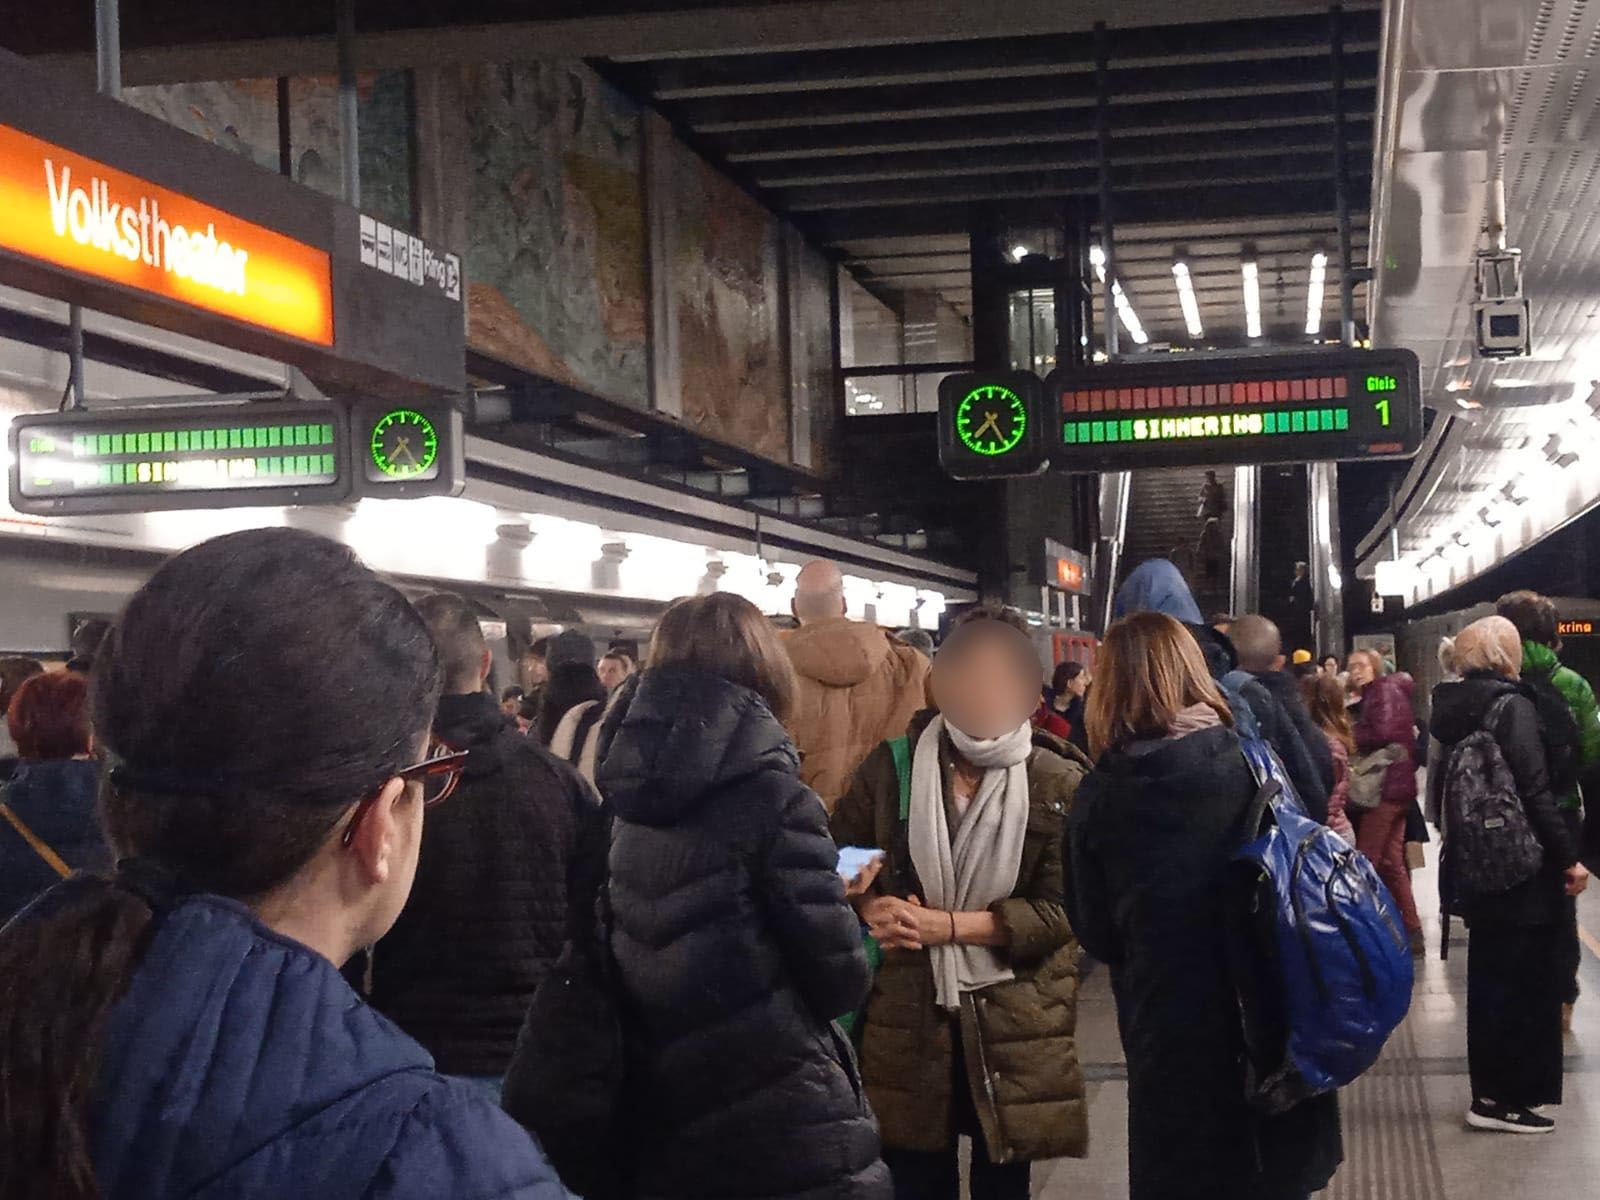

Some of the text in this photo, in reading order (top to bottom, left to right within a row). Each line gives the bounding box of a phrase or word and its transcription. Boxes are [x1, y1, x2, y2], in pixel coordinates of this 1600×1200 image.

[44, 158, 248, 296] Volkstheater
[424, 247, 446, 288] Ring
[1367, 376, 1396, 391] Gleis
[1375, 400, 1389, 425] 1
[1133, 413, 1262, 440] SIMMERING
